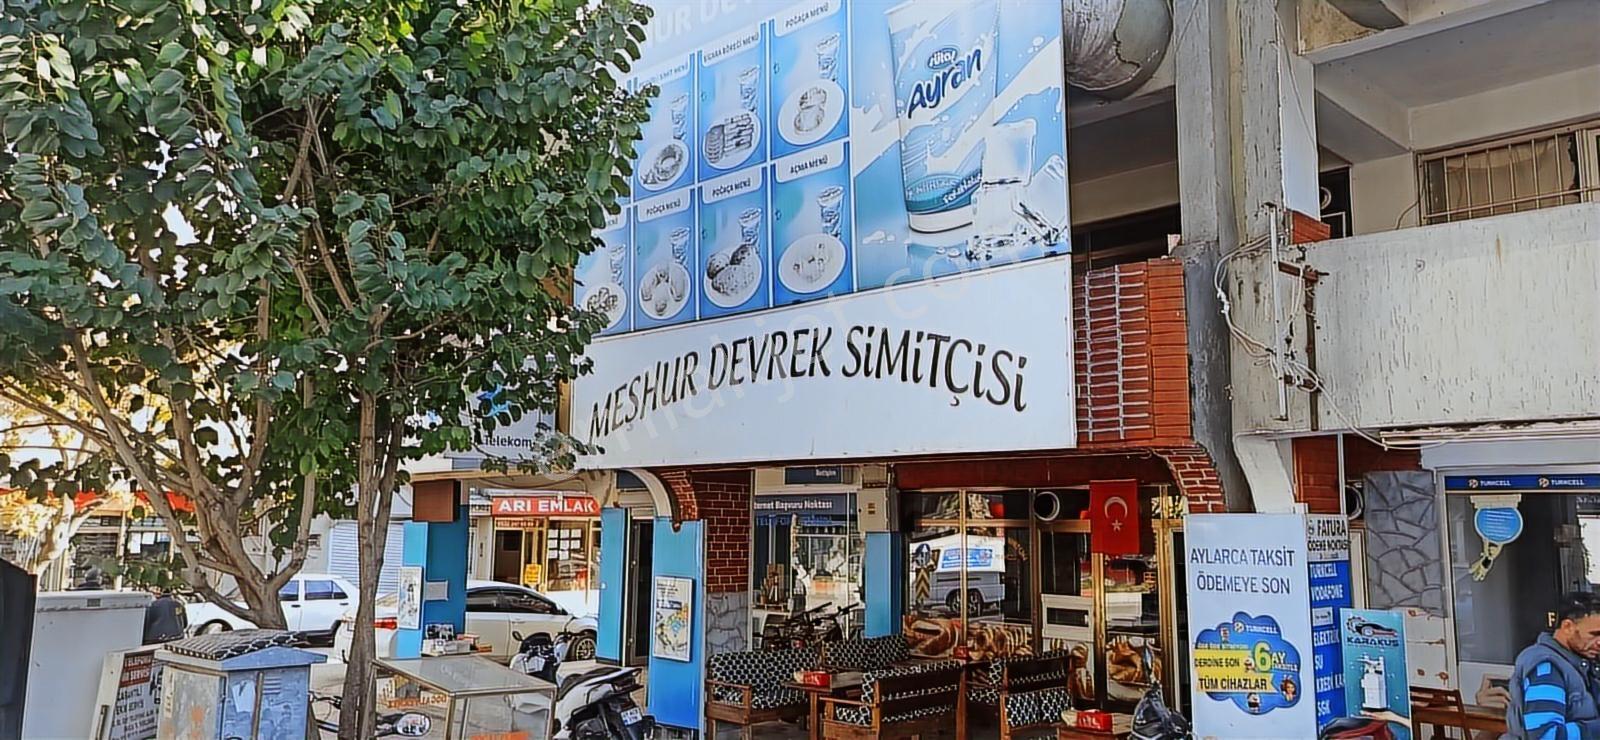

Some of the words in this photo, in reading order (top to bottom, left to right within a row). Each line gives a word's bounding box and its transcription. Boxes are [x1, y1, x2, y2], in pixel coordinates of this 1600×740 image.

[908, 49, 981, 118] Ayran
[589, 351, 699, 446] MEŞHUR
[708, 326, 833, 391] DEVREK
[483, 435, 532, 447] Telekom
[500, 500, 530, 512] ARI
[538, 500, 595, 512] EMLAK
[1317, 519, 1347, 536] FATURA
[1190, 548, 1248, 565] AYLARCA
[1250, 546, 1295, 567] TAKSİT
[1196, 571, 1259, 593] ÖDEMEYE
[1262, 577, 1291, 594] SON
[1311, 584, 1344, 600] VODAFONE
[1225, 657, 1240, 668] SON
[1254, 641, 1272, 672] 6
[1271, 652, 1286, 665] AY
[1198, 675, 1218, 689] TÜM
[1220, 675, 1267, 690] CİHAZLAR
